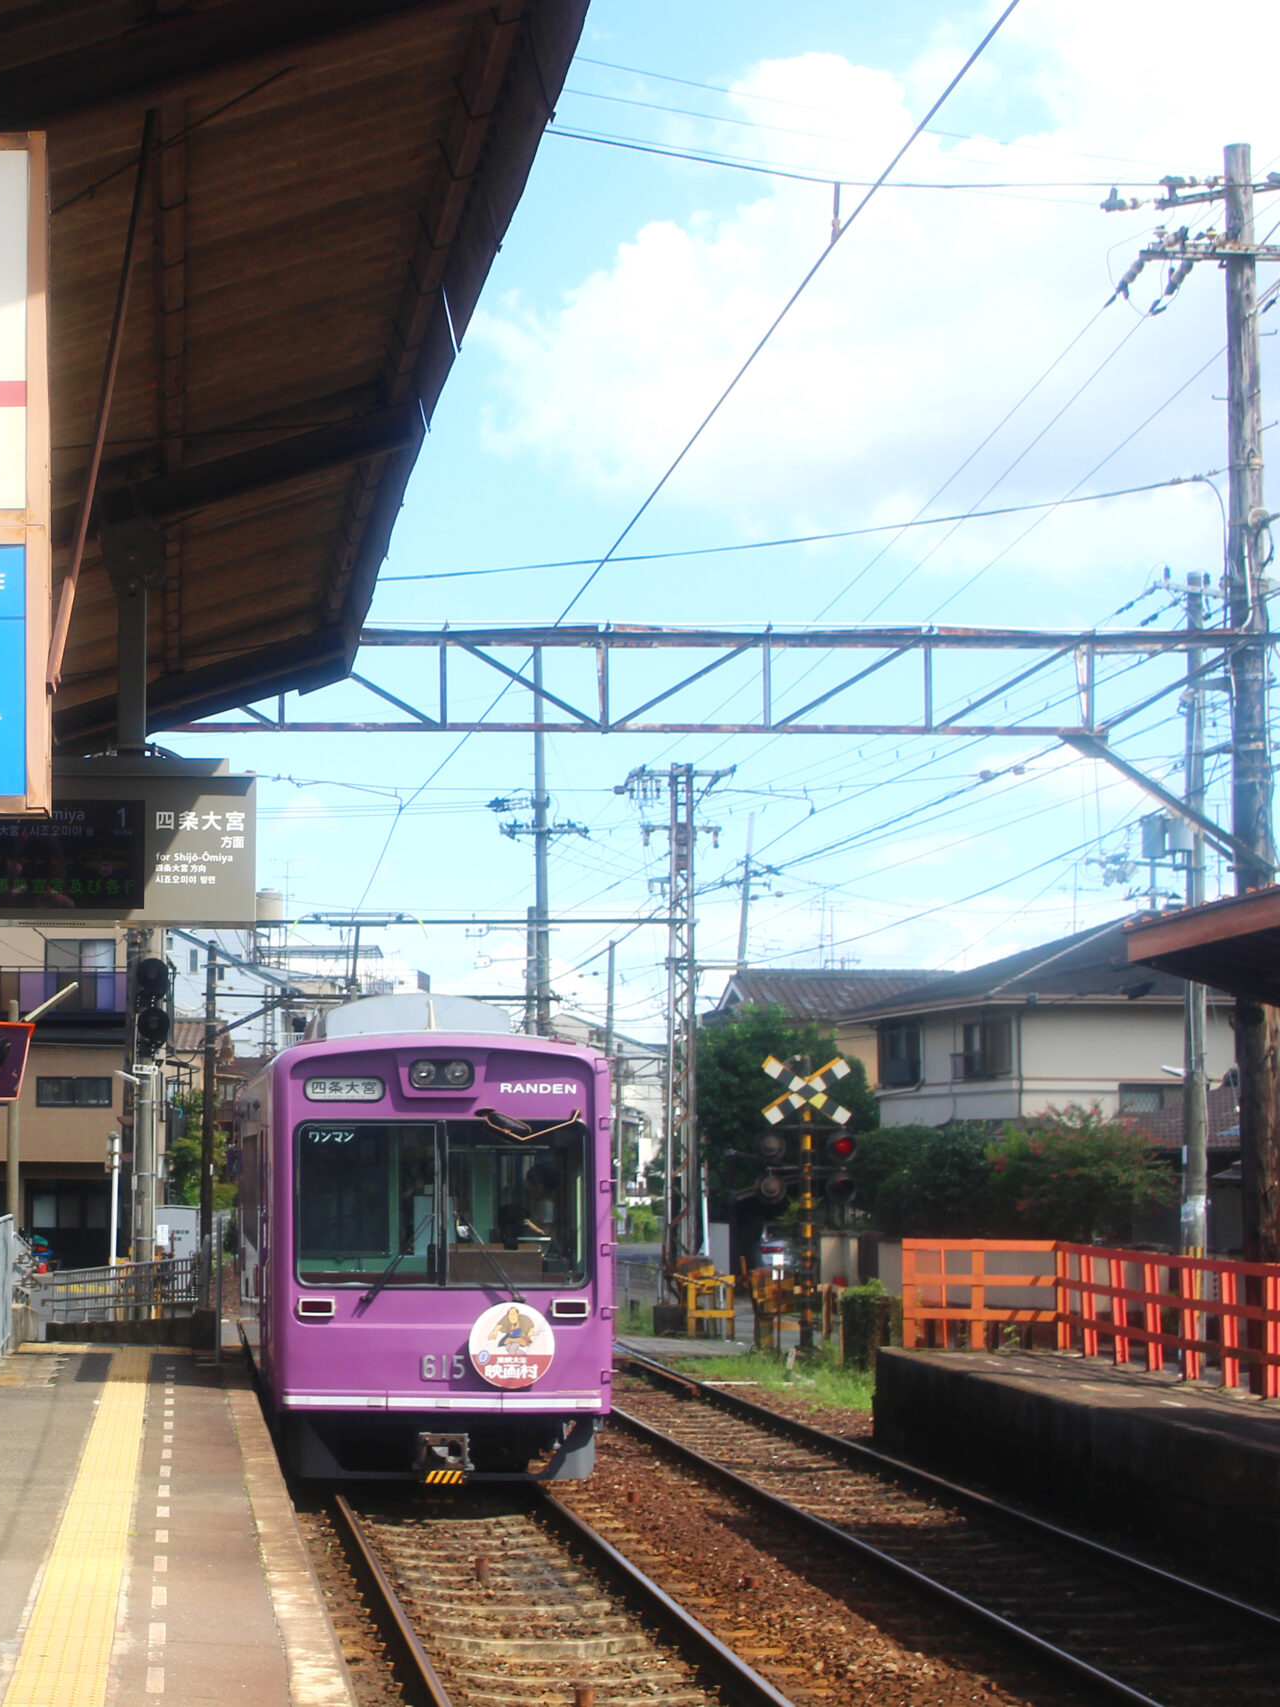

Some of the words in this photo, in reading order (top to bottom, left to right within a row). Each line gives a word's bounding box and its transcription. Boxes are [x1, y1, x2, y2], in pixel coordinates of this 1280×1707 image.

[155, 811, 245, 831] 四条大宮
[220, 836, 245, 849] 方面
[156, 852, 170, 861] for
[311, 1081, 377, 1095] 四条大宮
[500, 1082, 577, 1094] RANDEN
[308, 1131, 355, 1143] ワンマン
[422, 1354, 466, 1380] 615
[484, 1363, 539, 1379] 映画村
